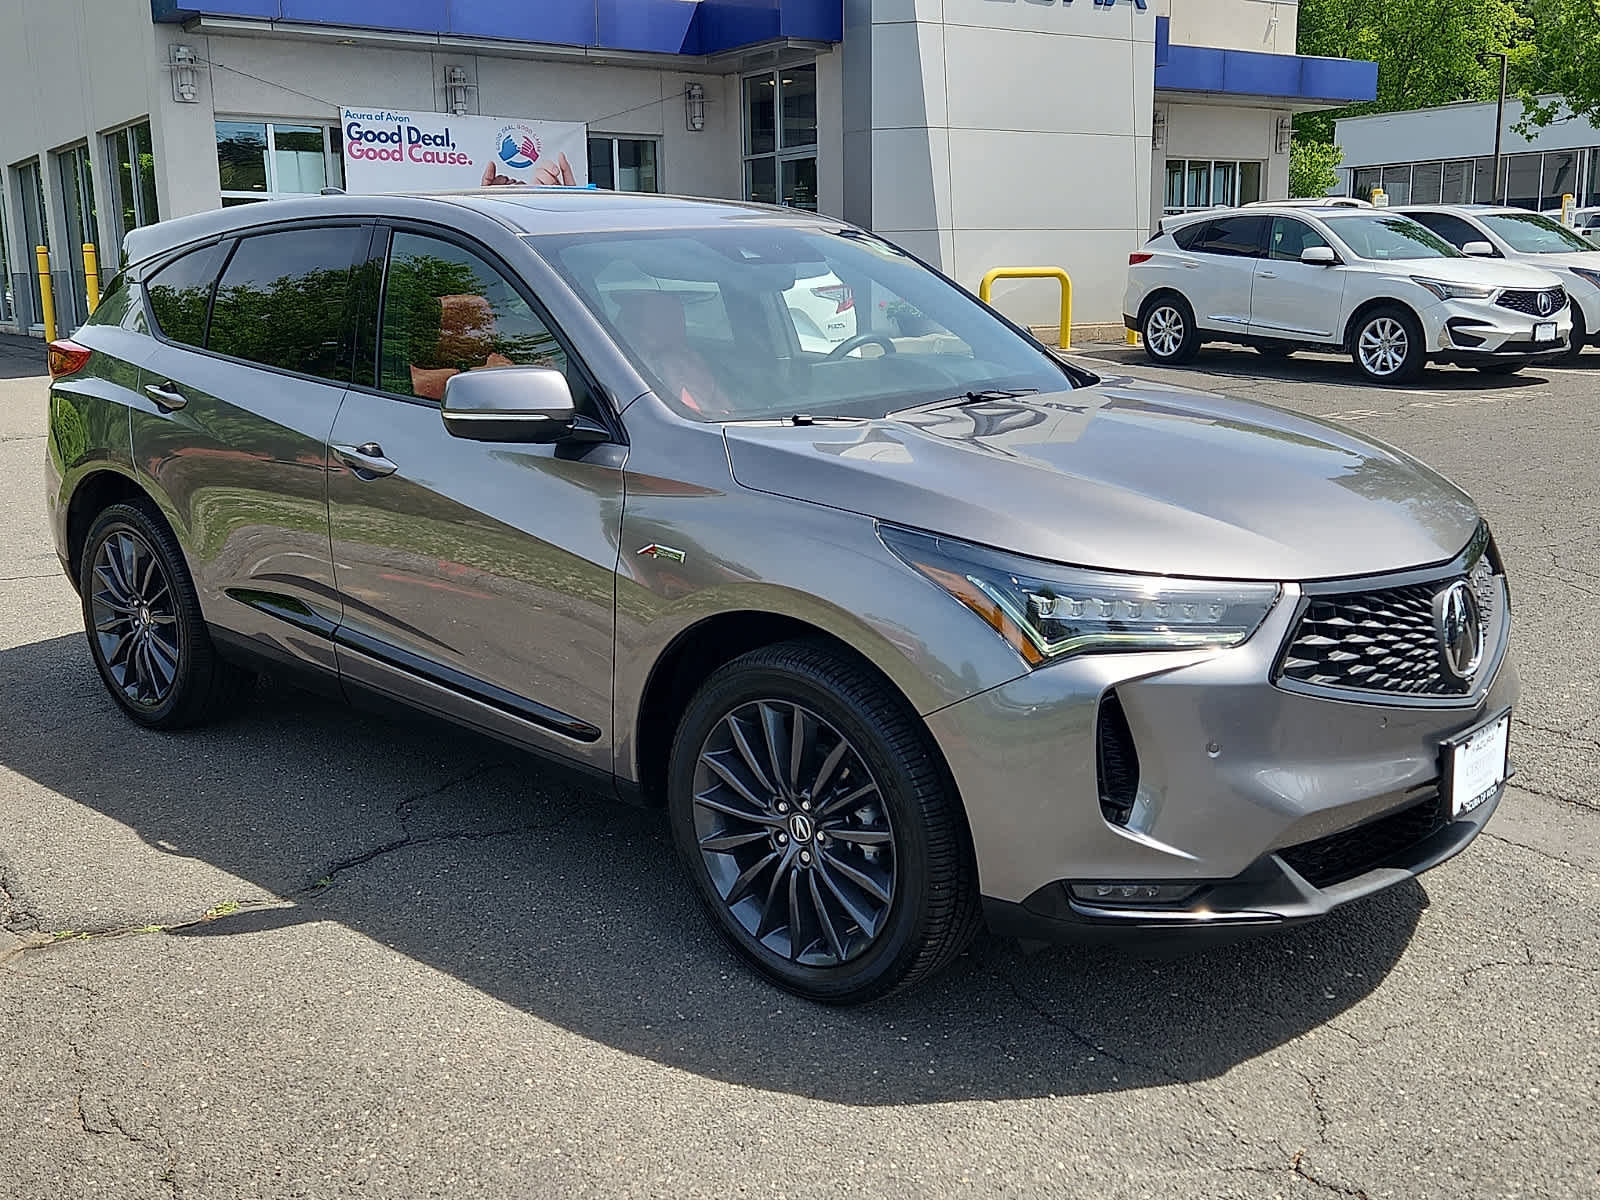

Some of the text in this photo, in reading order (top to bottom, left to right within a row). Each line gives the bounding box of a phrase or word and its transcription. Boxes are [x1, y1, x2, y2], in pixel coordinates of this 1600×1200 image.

[345, 110, 410, 122] Acura of Avon
[346, 122, 456, 151] Good Deal,
[347, 139, 473, 165] Good Cause.
